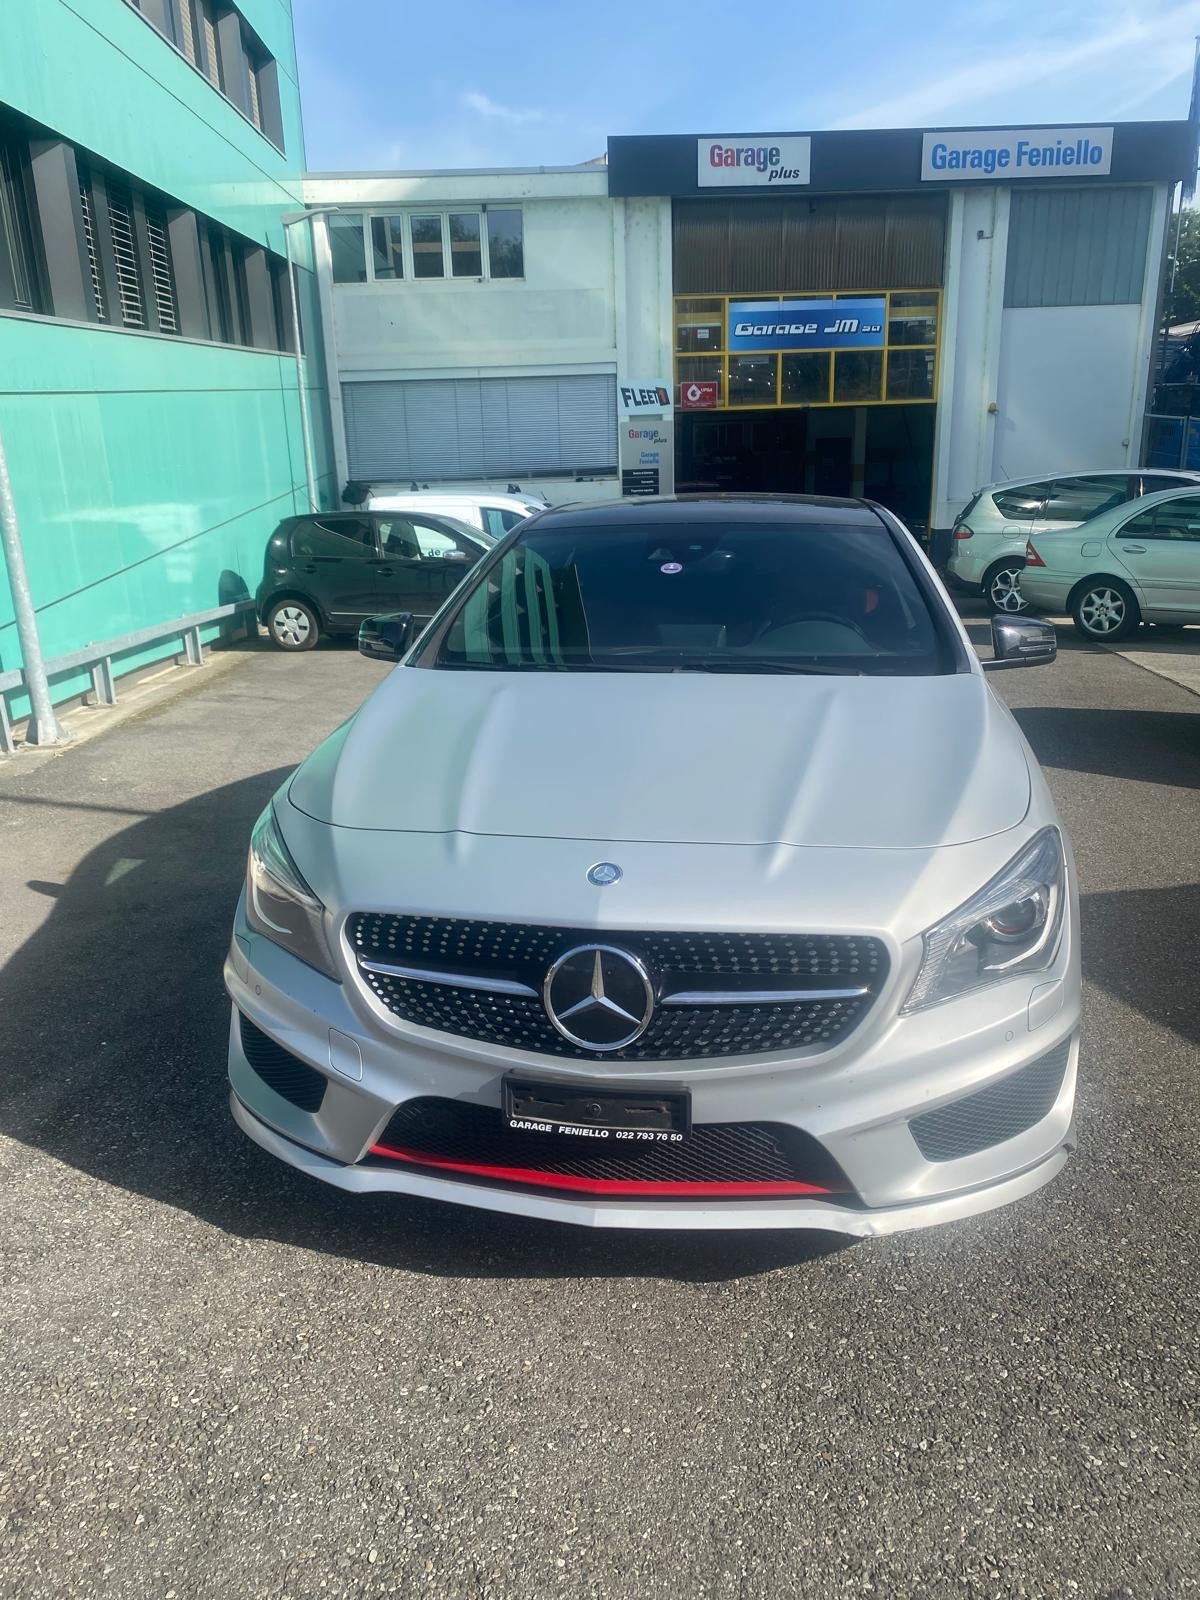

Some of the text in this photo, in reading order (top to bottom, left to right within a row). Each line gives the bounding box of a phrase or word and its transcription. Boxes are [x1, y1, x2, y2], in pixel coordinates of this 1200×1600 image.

[709, 144, 781, 172] Garage
[930, 139, 1103, 174] Garage Feniello
[768, 166, 800, 182] plus
[734, 322, 818, 337] Garage
[823, 319, 859, 334] JM
[628, 429, 659, 440] Garage
[509, 1119, 683, 1141] GARAGE FENIELLO 022 793 76 50
